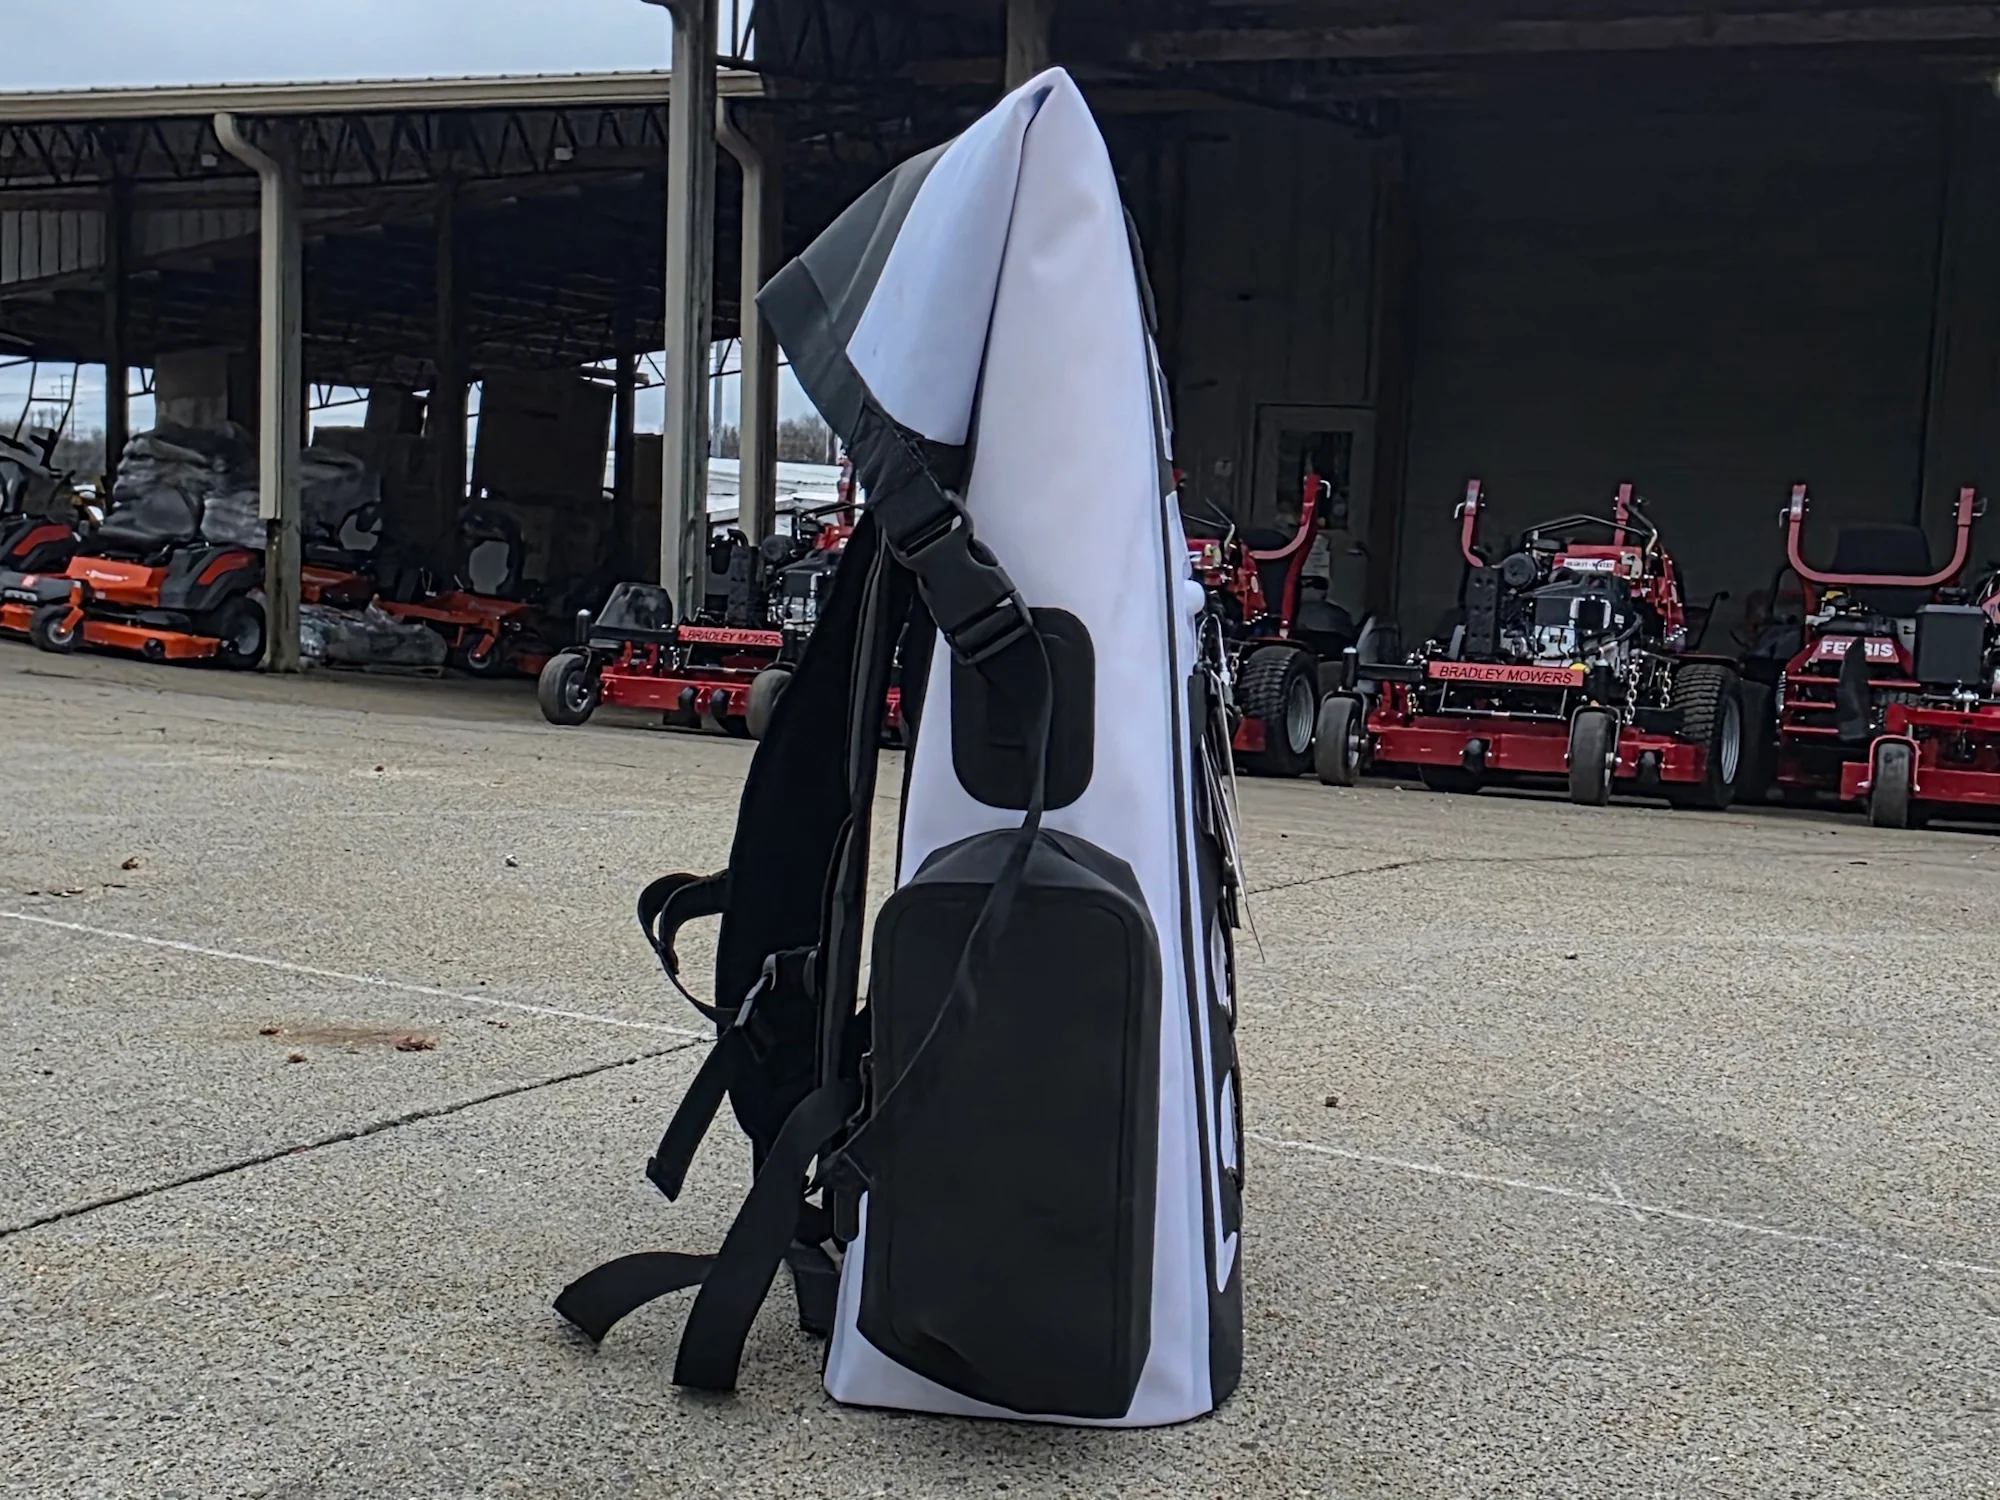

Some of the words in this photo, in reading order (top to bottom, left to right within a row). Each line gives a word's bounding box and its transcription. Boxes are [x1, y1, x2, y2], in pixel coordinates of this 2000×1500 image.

[687, 629, 736, 642] BRADLEY
[1821, 640, 1893, 657] FERIS
[1439, 665, 1504, 680] BRADLEY
[1506, 669, 1574, 685] MOWERS
